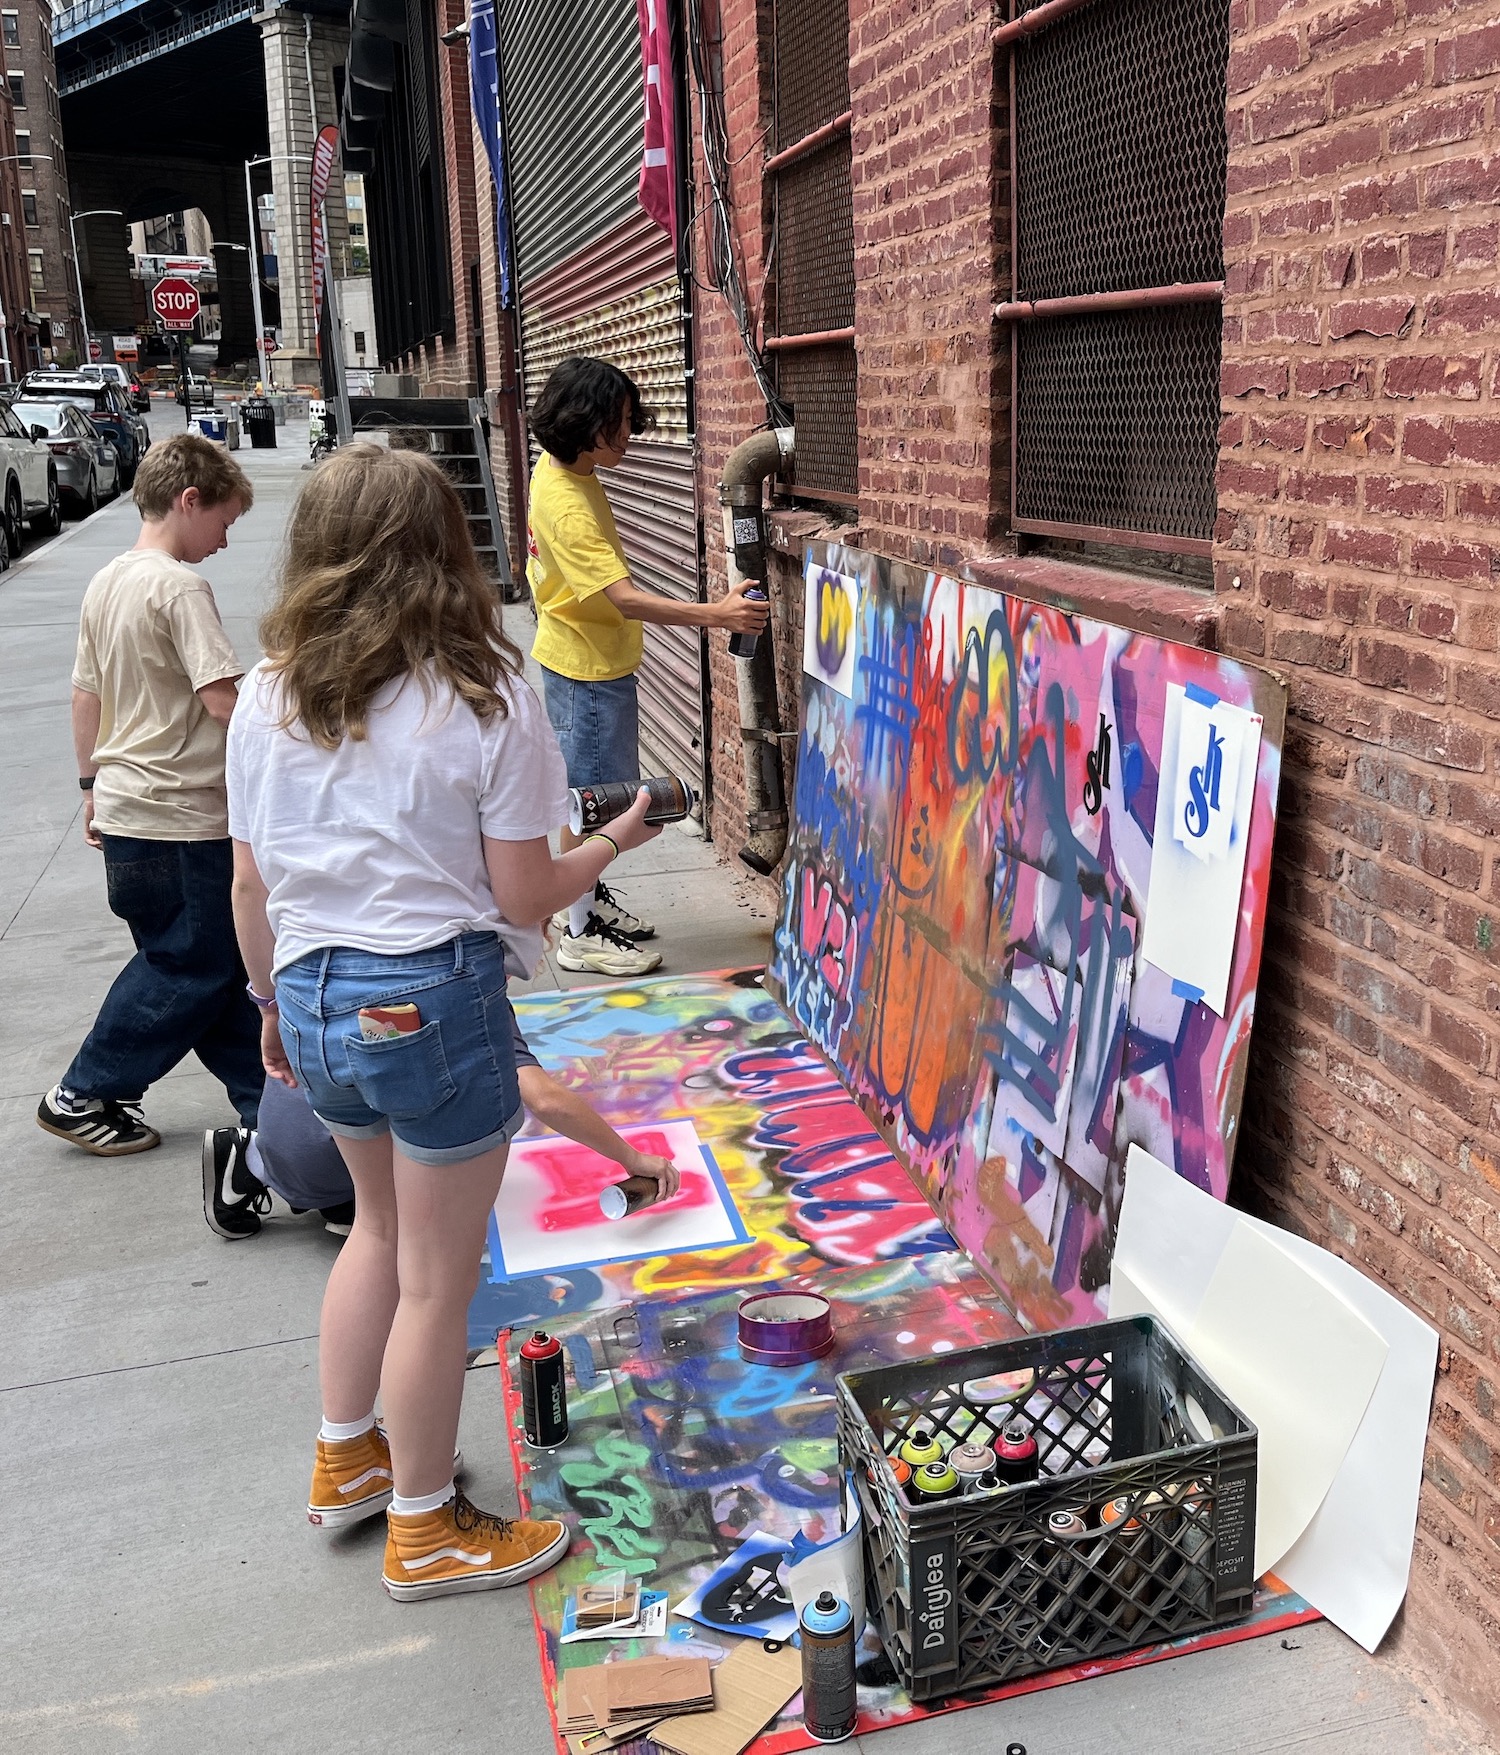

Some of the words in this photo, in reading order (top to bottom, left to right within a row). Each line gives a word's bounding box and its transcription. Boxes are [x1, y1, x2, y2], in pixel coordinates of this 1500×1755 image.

[312, 136, 334, 219] INDO
[156, 292, 196, 310] STOP
[551, 1382, 562, 1425] BLACK
[1216, 1556, 1245, 1568] DEPOSIT
[1218, 1566, 1238, 1576] CASE
[919, 1552, 952, 1650] Dairylea
